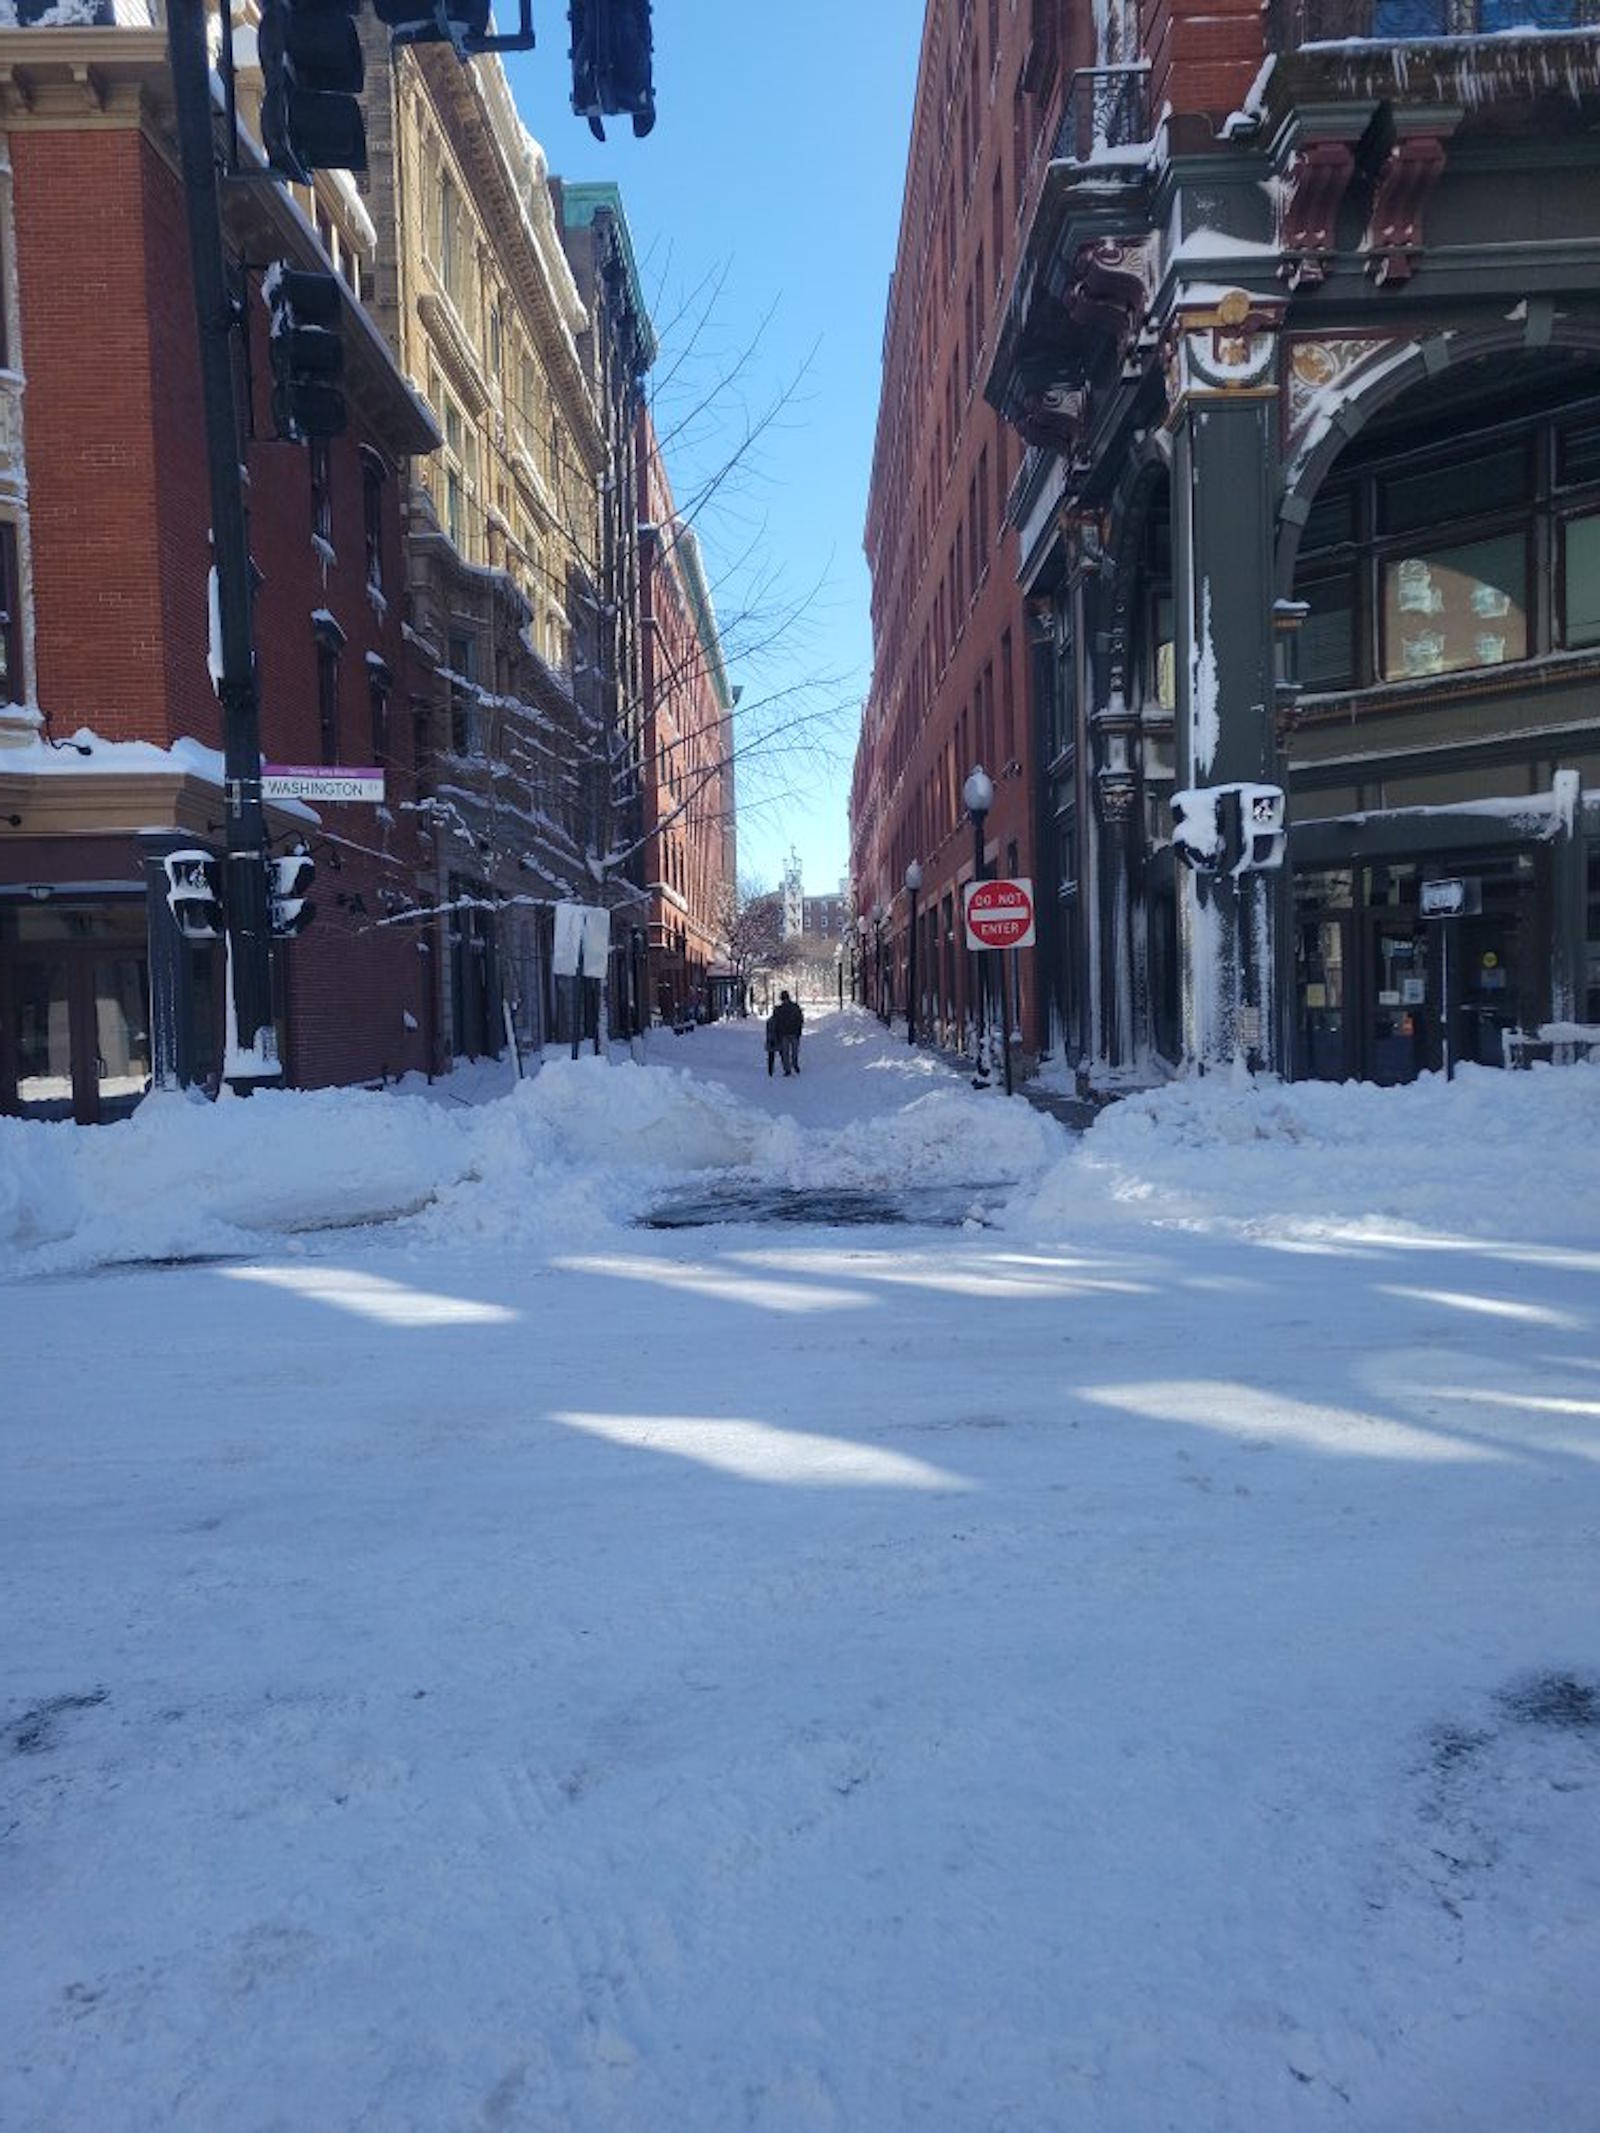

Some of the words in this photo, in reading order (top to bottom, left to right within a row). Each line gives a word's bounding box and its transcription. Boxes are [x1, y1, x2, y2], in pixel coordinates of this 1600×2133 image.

[268, 781, 362, 796] WASHINGTON
[975, 895, 992, 907] DO
[998, 892, 1022, 905] NOT
[981, 922, 1020, 935] ENTER
